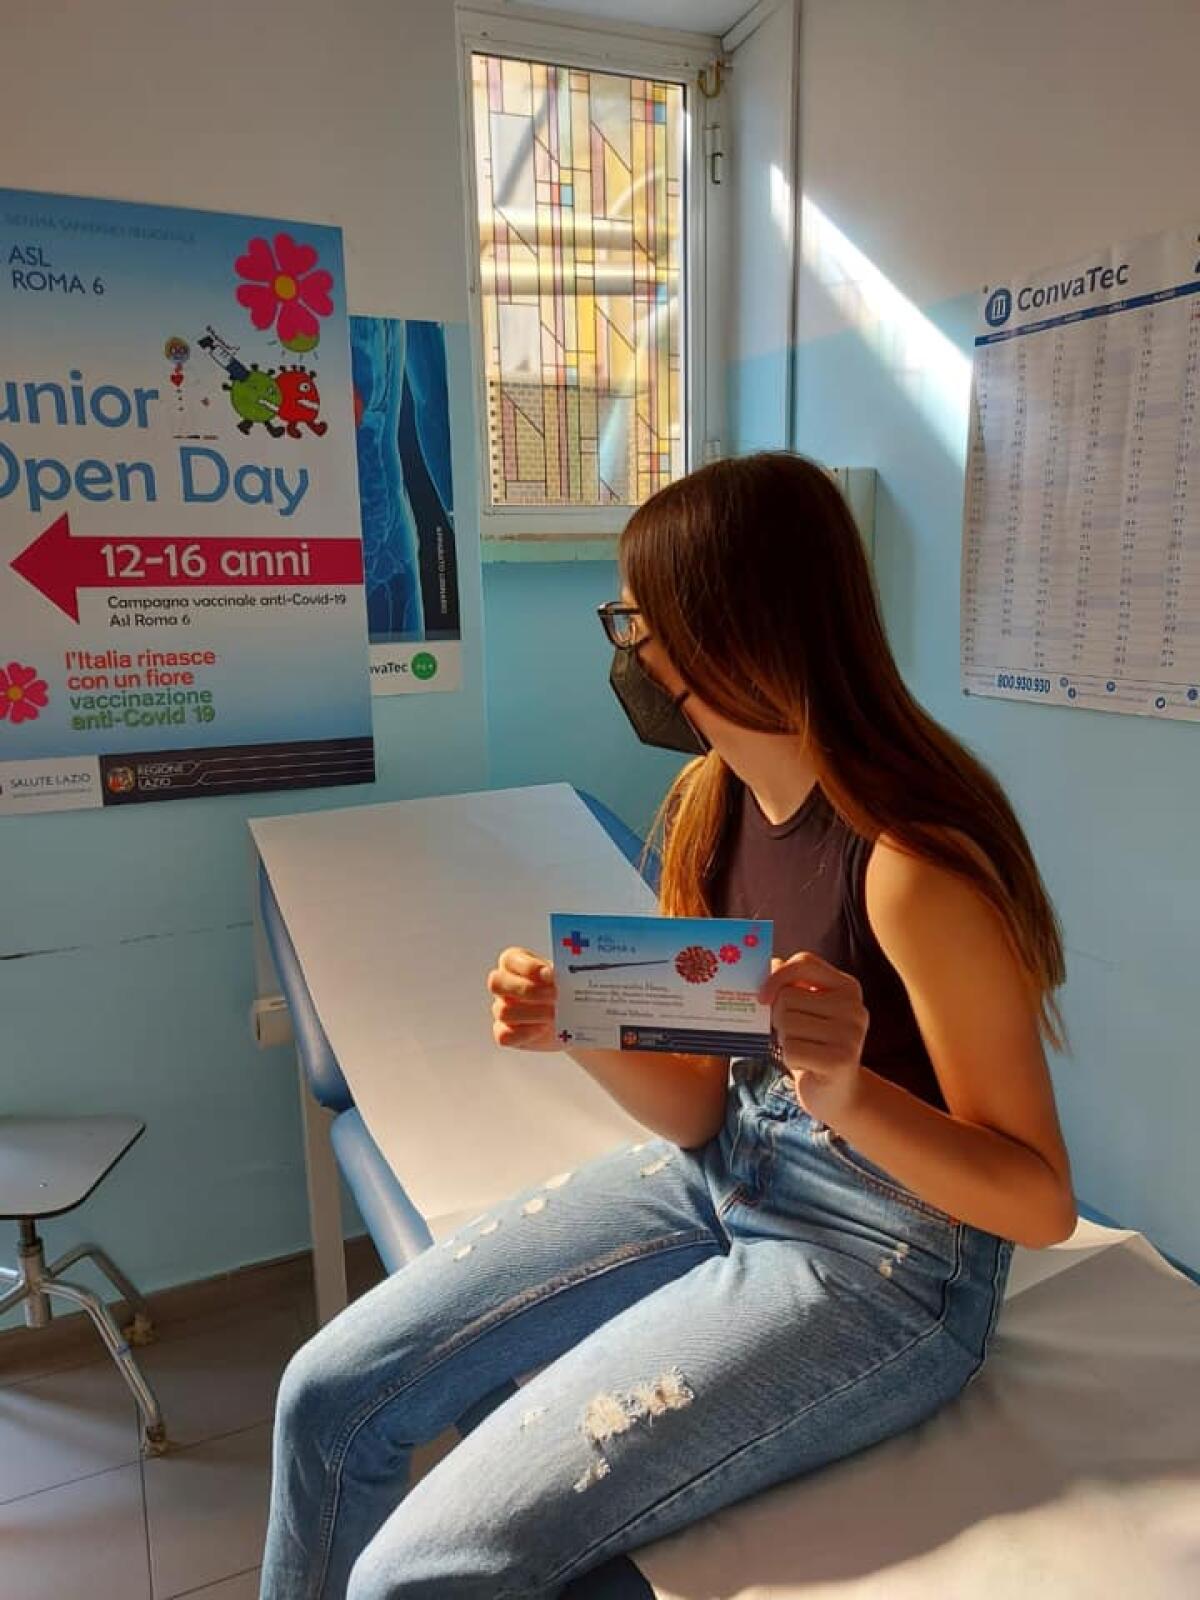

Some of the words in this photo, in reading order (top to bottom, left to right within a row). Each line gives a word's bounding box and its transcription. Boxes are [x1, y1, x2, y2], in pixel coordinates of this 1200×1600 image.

[8, 244, 52, 267] ASL
[12, 269, 86, 294] ROMA
[92, 277, 104, 295] 6
[1017, 264, 1129, 311] ConvaTec
[179, 446, 309, 516] Day
[100, 543, 207, 579] 12-16
[219, 542, 312, 577] anni
[107, 595, 189, 610] Campagna
[193, 594, 257, 608] vaccinale
[259, 593, 347, 607] anti-Covid-19
[109, 614, 131, 627] Asl
[134, 614, 178, 627] Roma
[182, 614, 191, 626] 6
[65, 649, 132, 670] l'Italia
[137, 648, 216, 667] rinasce
[67, 674, 109, 690] con
[114, 673, 141, 688] un
[146, 669, 194, 687] fiore
[69, 688, 213, 709] vaccinazione
[71, 706, 186, 731] anti-Covid
[192, 704, 216, 723] 19
[10, 775, 54, 788] SALUTE
[56, 773, 91, 786] LAZIO
